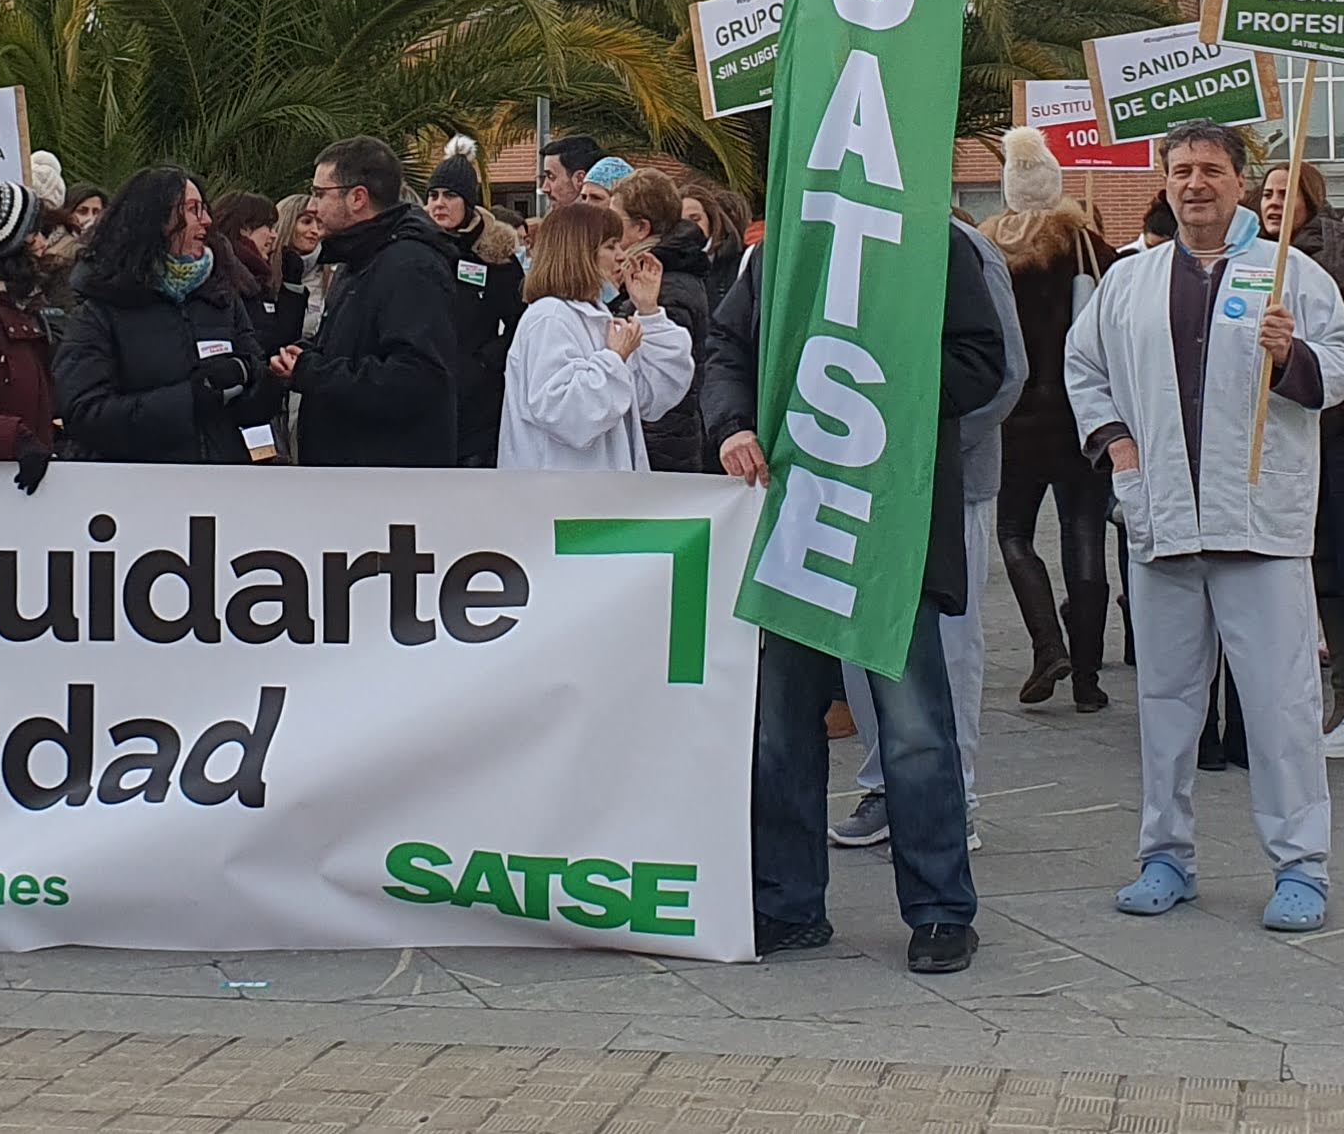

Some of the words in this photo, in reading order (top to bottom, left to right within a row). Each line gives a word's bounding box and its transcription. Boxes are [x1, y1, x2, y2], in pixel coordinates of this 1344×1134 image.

[715, 2, 784, 47] GRUPO
[1121, 43, 1222, 83] SANIDAD
[1031, 100, 1092, 118] SUSTITU
[1113, 96, 1147, 122] DE
[1150, 68, 1251, 111] CALIDAD
[382, 841, 698, 937] SATSE
